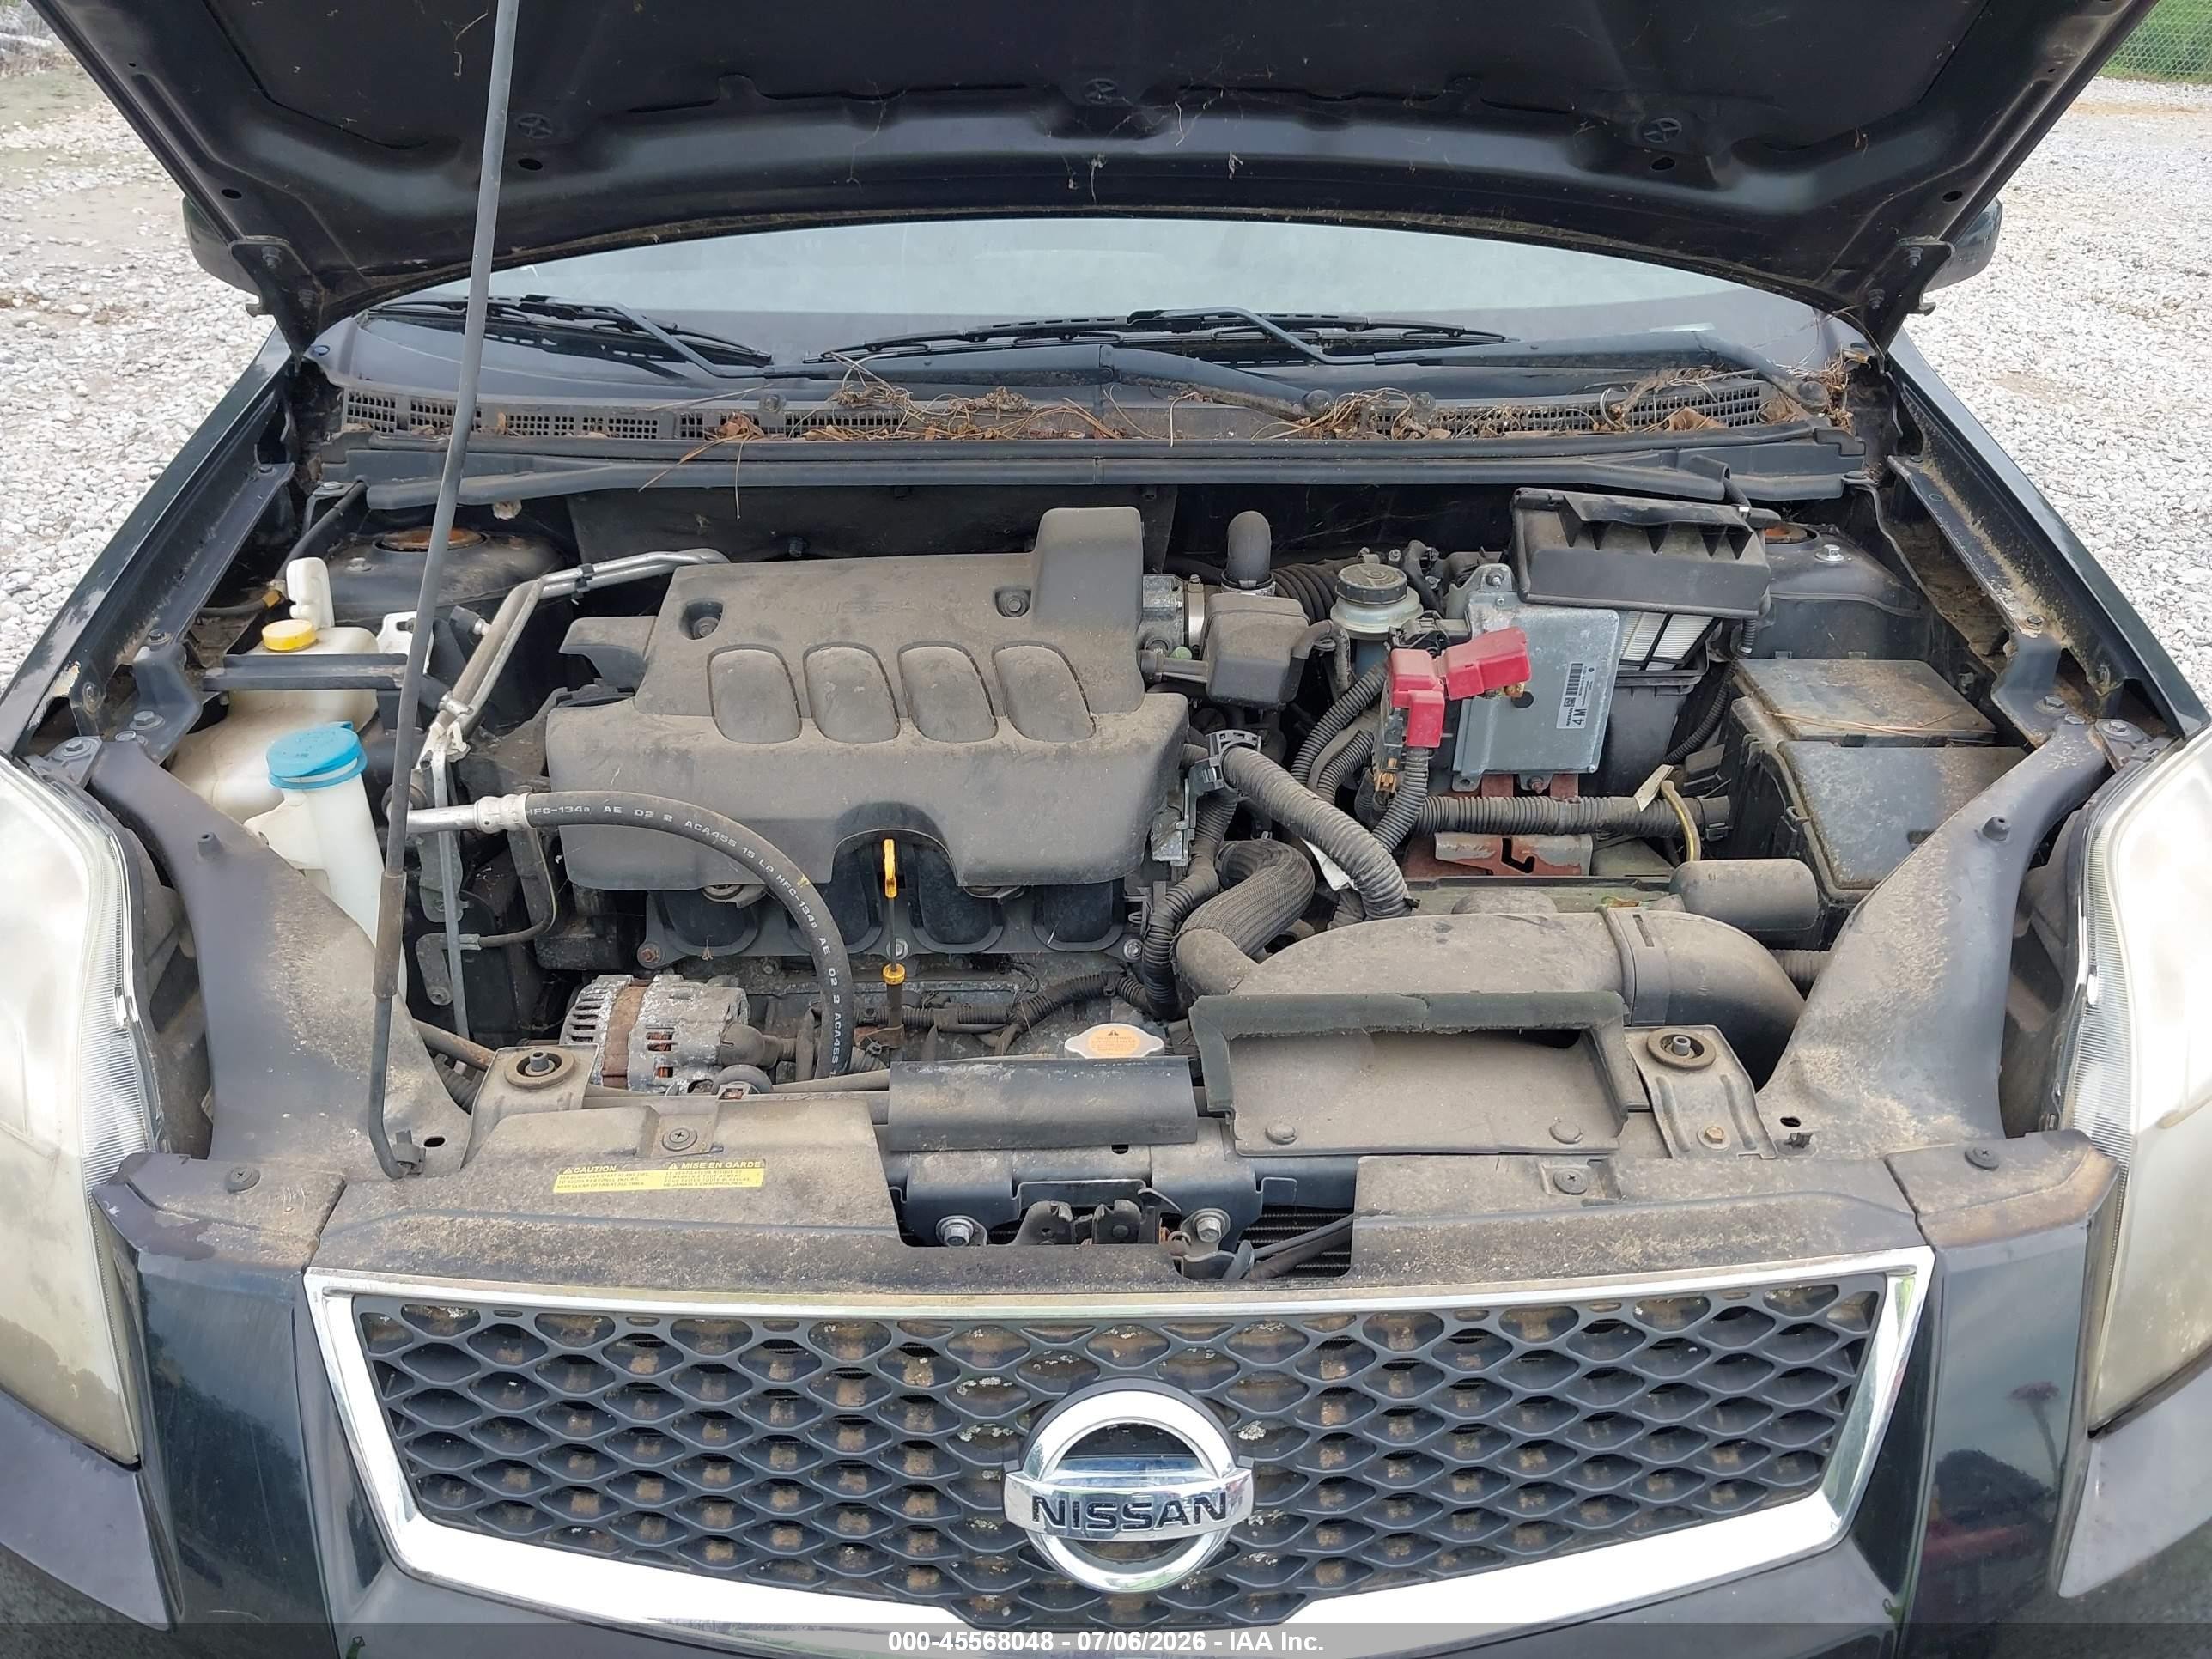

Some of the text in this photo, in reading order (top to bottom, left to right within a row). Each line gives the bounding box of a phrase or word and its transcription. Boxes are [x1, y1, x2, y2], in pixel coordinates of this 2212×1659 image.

[742, 847, 756, 859] 15
[775, 873, 817, 928] HFC-134a
[818, 937, 830, 956] AE
[833, 994, 841, 1004] 2
[574, 1165, 617, 1174] CAUTION
[1031, 1491, 1226, 1531] NISSAN
